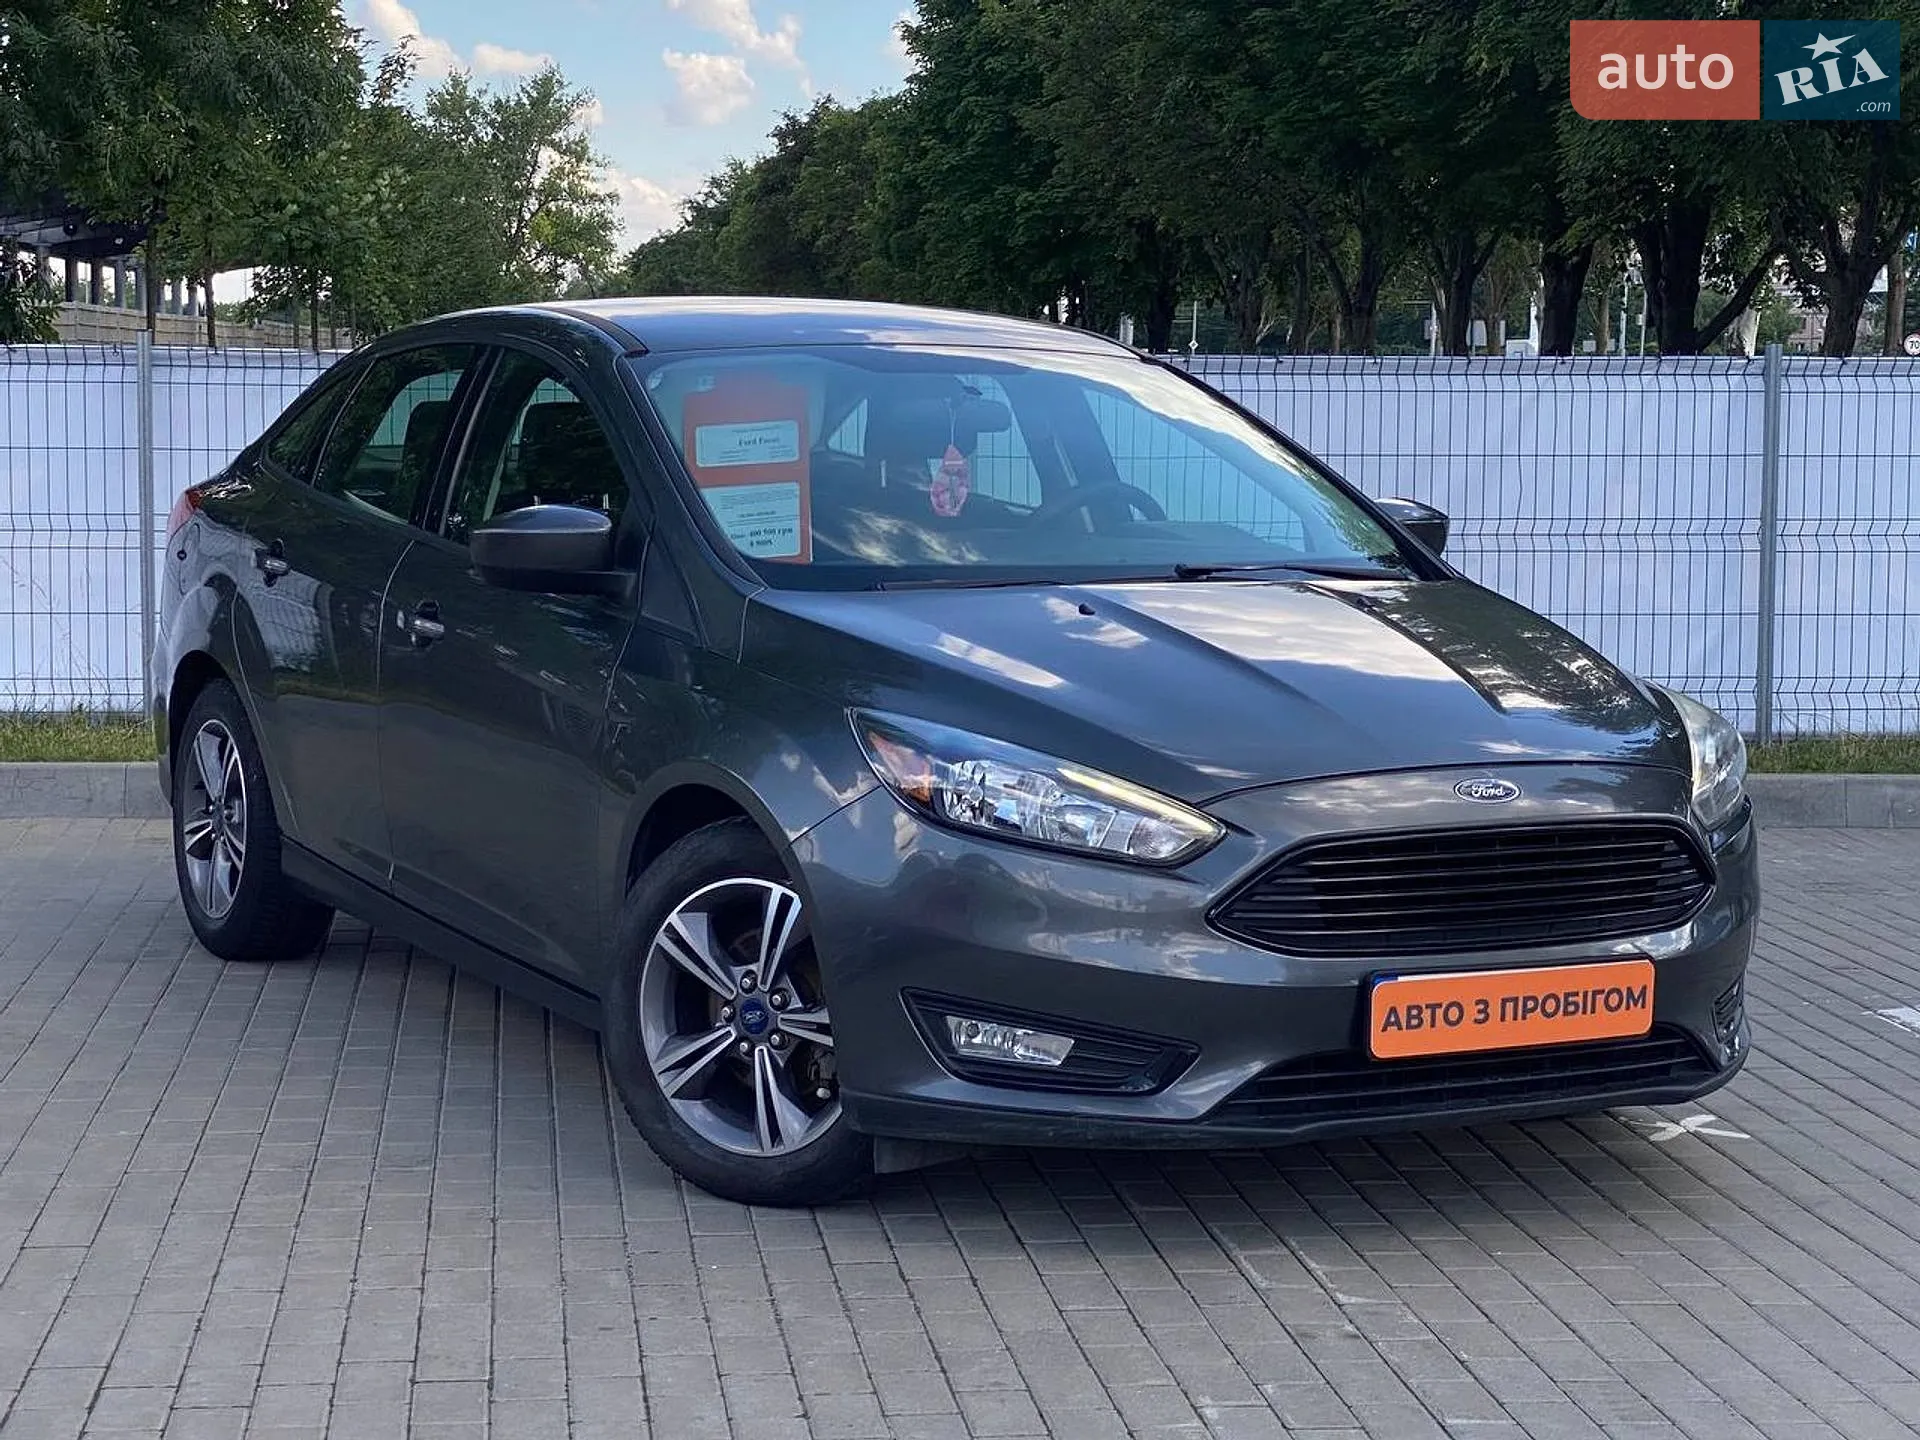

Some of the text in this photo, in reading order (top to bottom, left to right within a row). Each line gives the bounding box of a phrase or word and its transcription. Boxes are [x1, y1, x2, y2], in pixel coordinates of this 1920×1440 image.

[1467, 783, 1509, 798] Ford
[1381, 1001, 1464, 1032] АВТО
[1500, 984, 1648, 1022] ПРОБІГОМ
